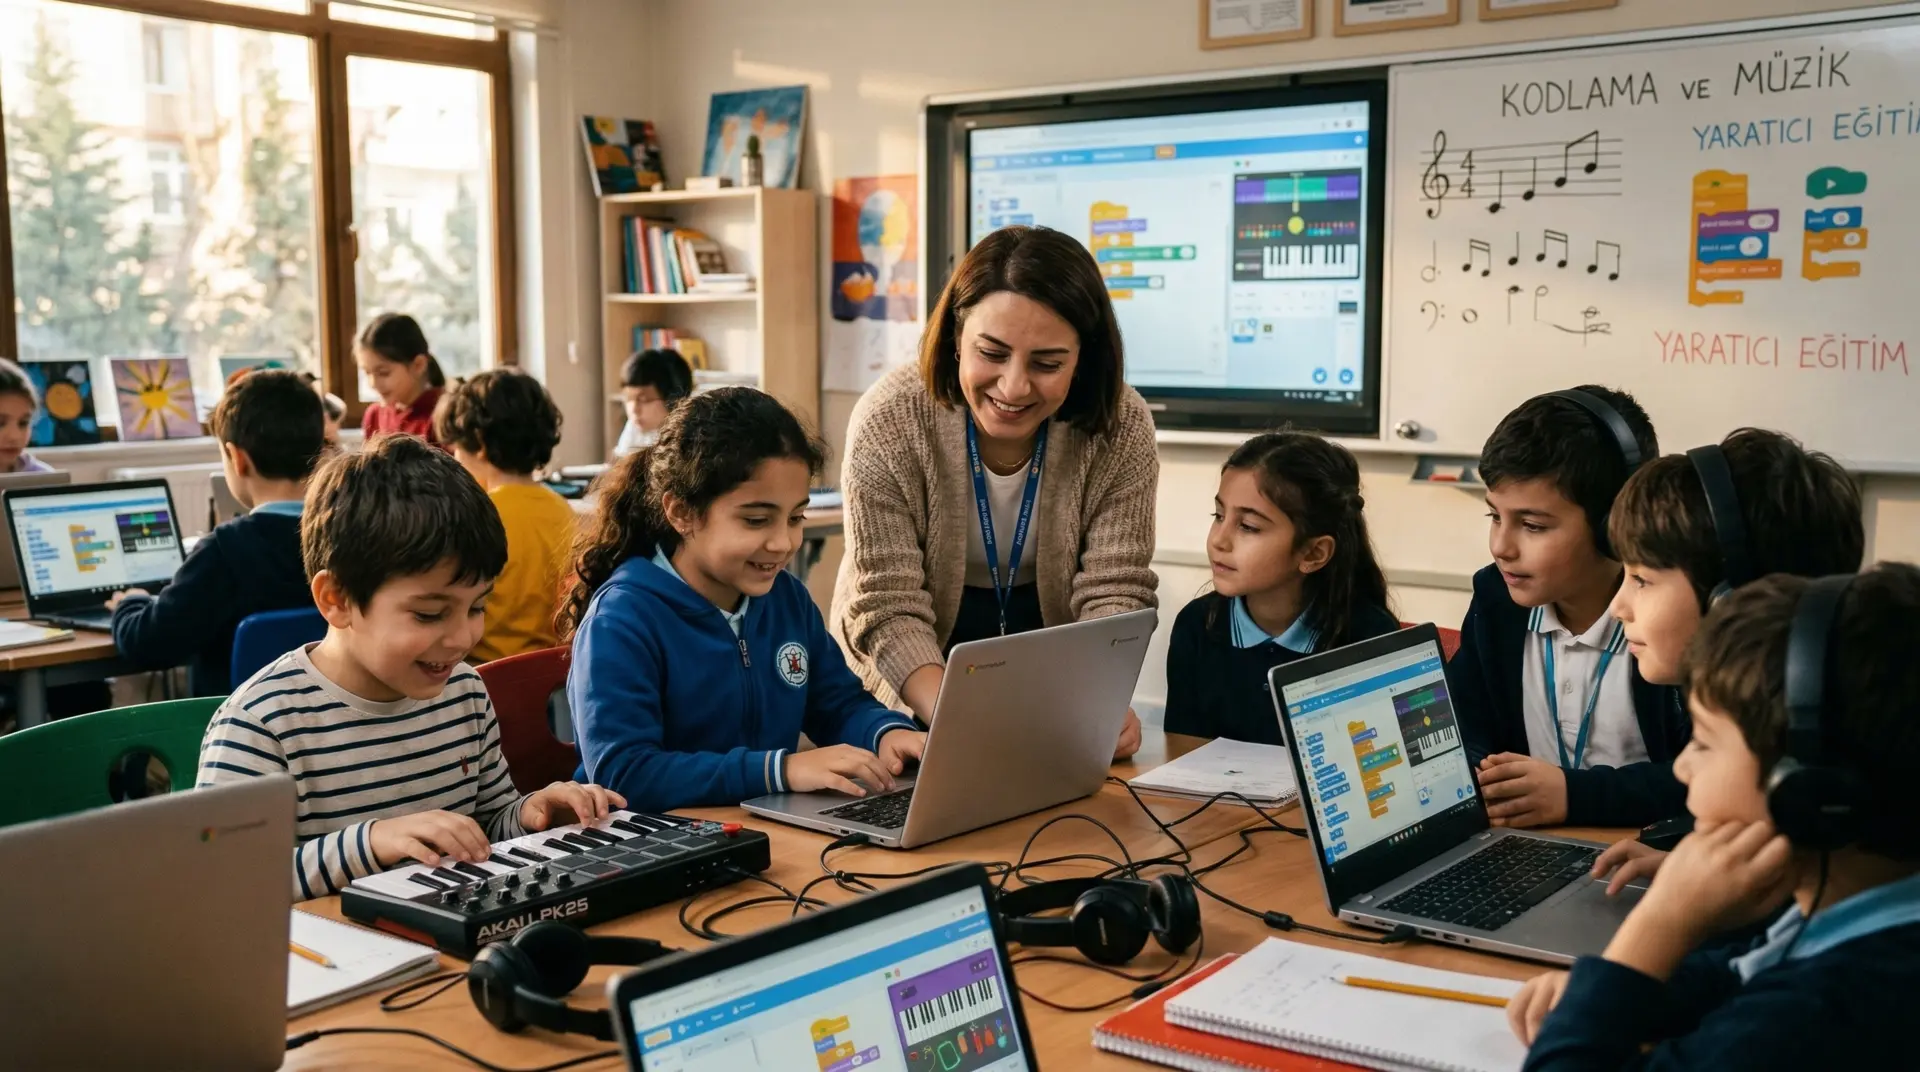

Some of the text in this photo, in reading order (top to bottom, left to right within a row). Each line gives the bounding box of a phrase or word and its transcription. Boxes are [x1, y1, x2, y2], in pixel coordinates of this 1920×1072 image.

[1502, 43, 1851, 118] KODLAMA VE MÜZİK
[1693, 117, 1813, 151] YARATICI
[1460, 149, 1476, 176] 4
[1460, 177, 1476, 198] 4
[1653, 330, 1909, 376] YARATICI EĞİTİM
[476, 915, 526, 940] AKAI
